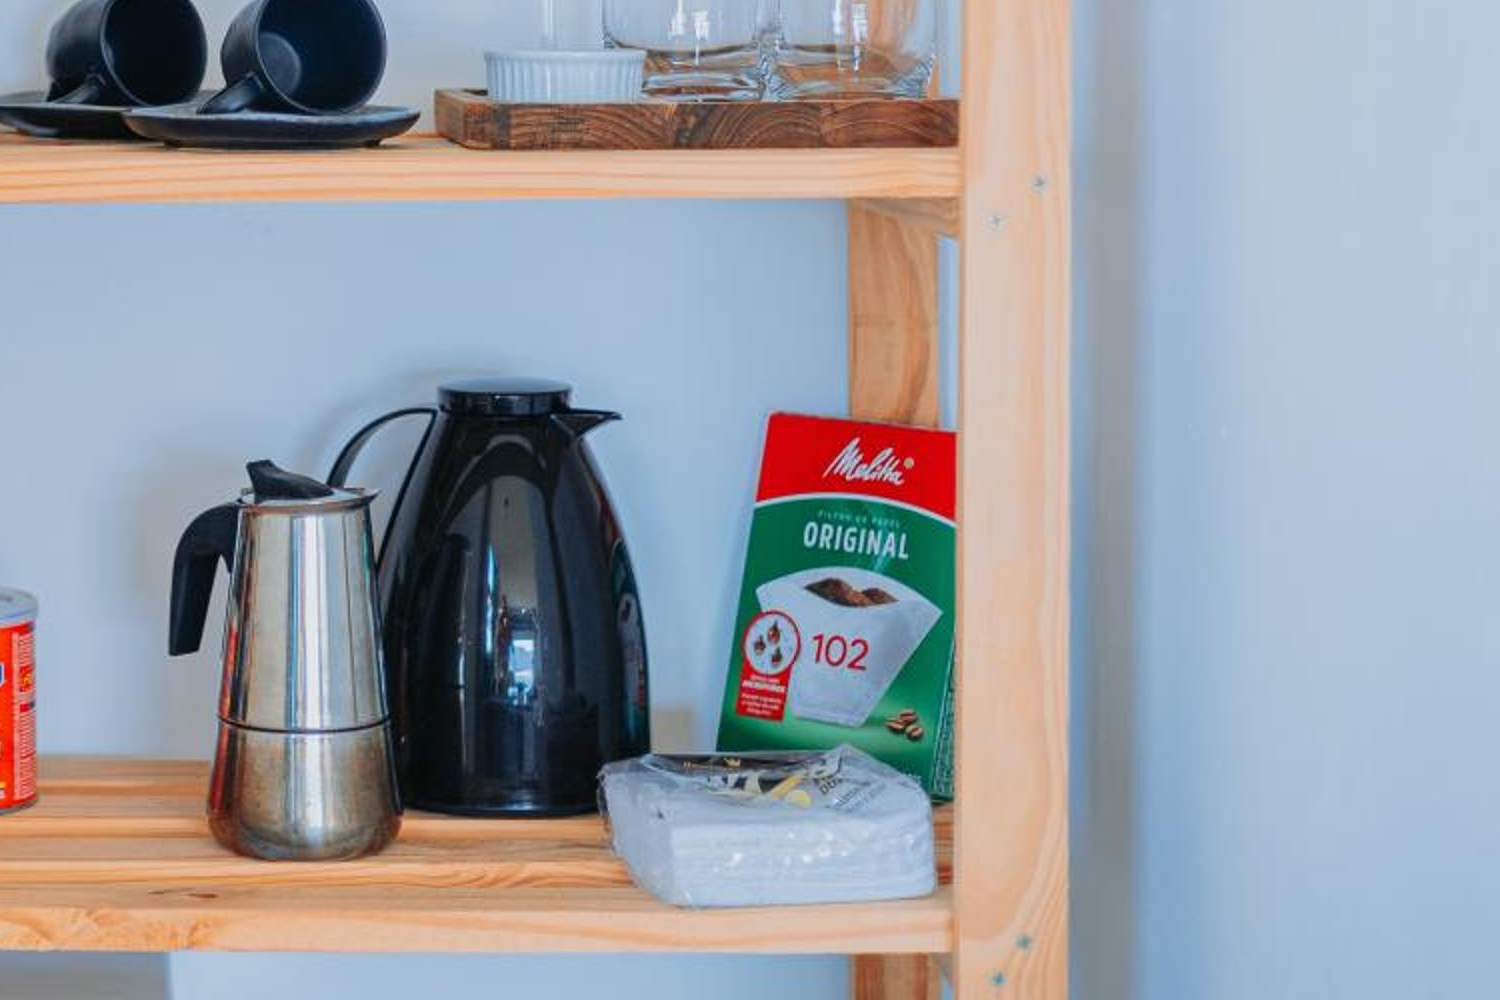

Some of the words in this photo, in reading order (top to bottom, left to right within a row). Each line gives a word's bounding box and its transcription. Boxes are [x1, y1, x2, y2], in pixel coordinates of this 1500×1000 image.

[822, 437, 905, 486] Melitta
[803, 521, 909, 560] ORIGINAL
[813, 633, 869, 671] 102
